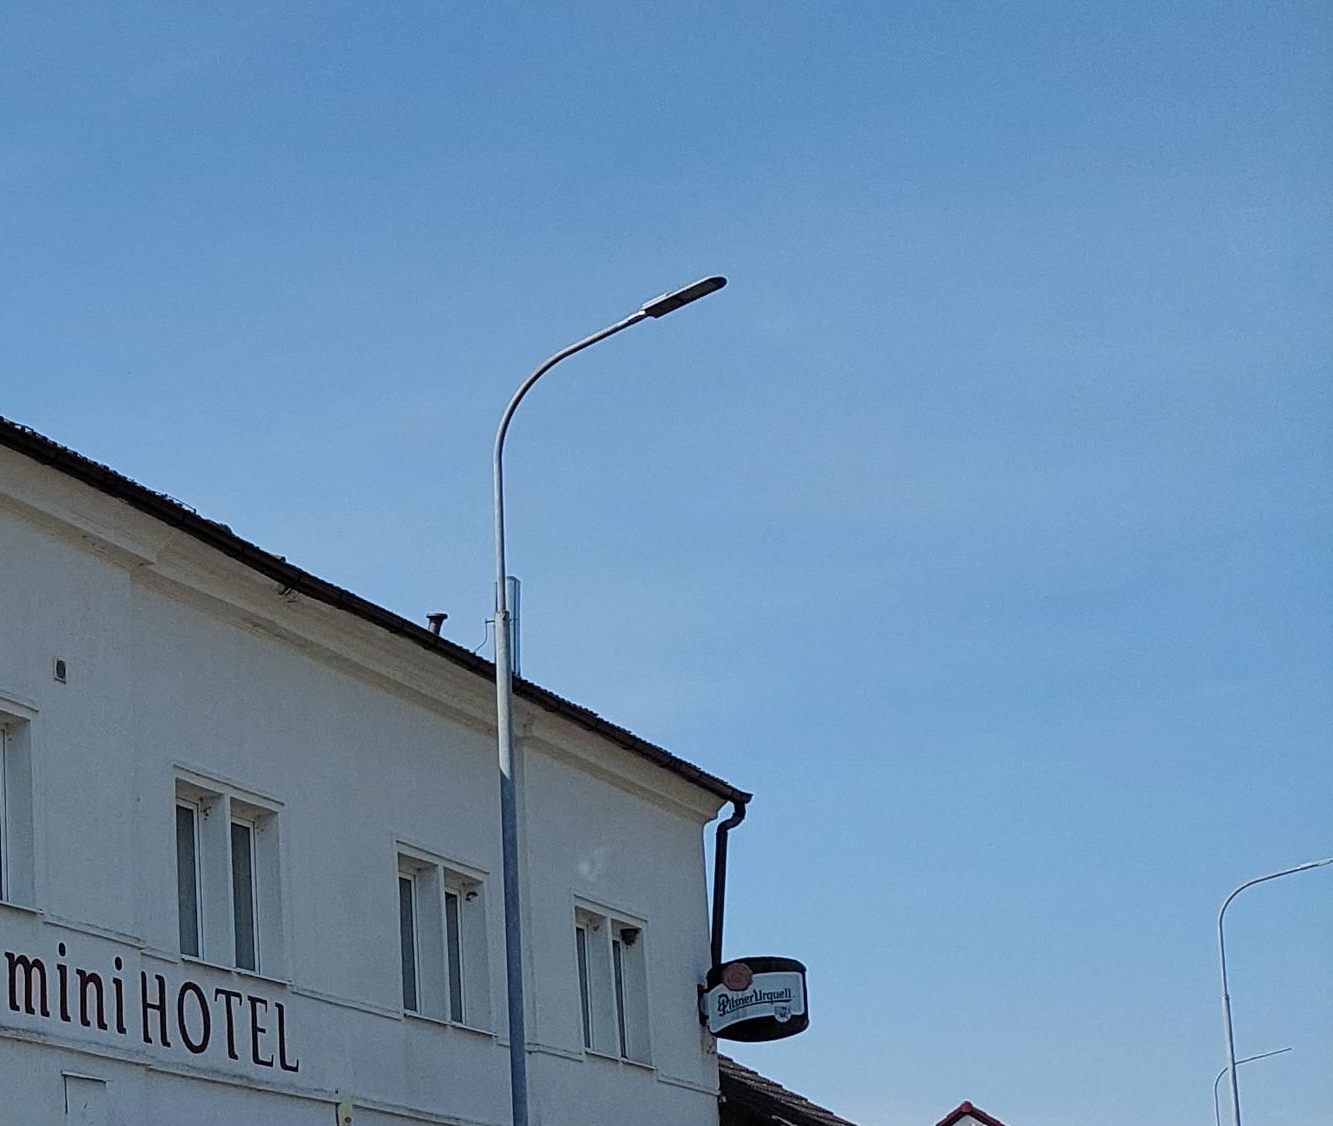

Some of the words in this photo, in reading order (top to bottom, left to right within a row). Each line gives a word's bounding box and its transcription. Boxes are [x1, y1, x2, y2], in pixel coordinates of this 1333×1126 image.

[4, 941, 127, 1036] mini
[140, 970, 300, 1073] HOTEL
[717, 993, 755, 1017] Pilsner
[753, 987, 792, 1005] Urquell
